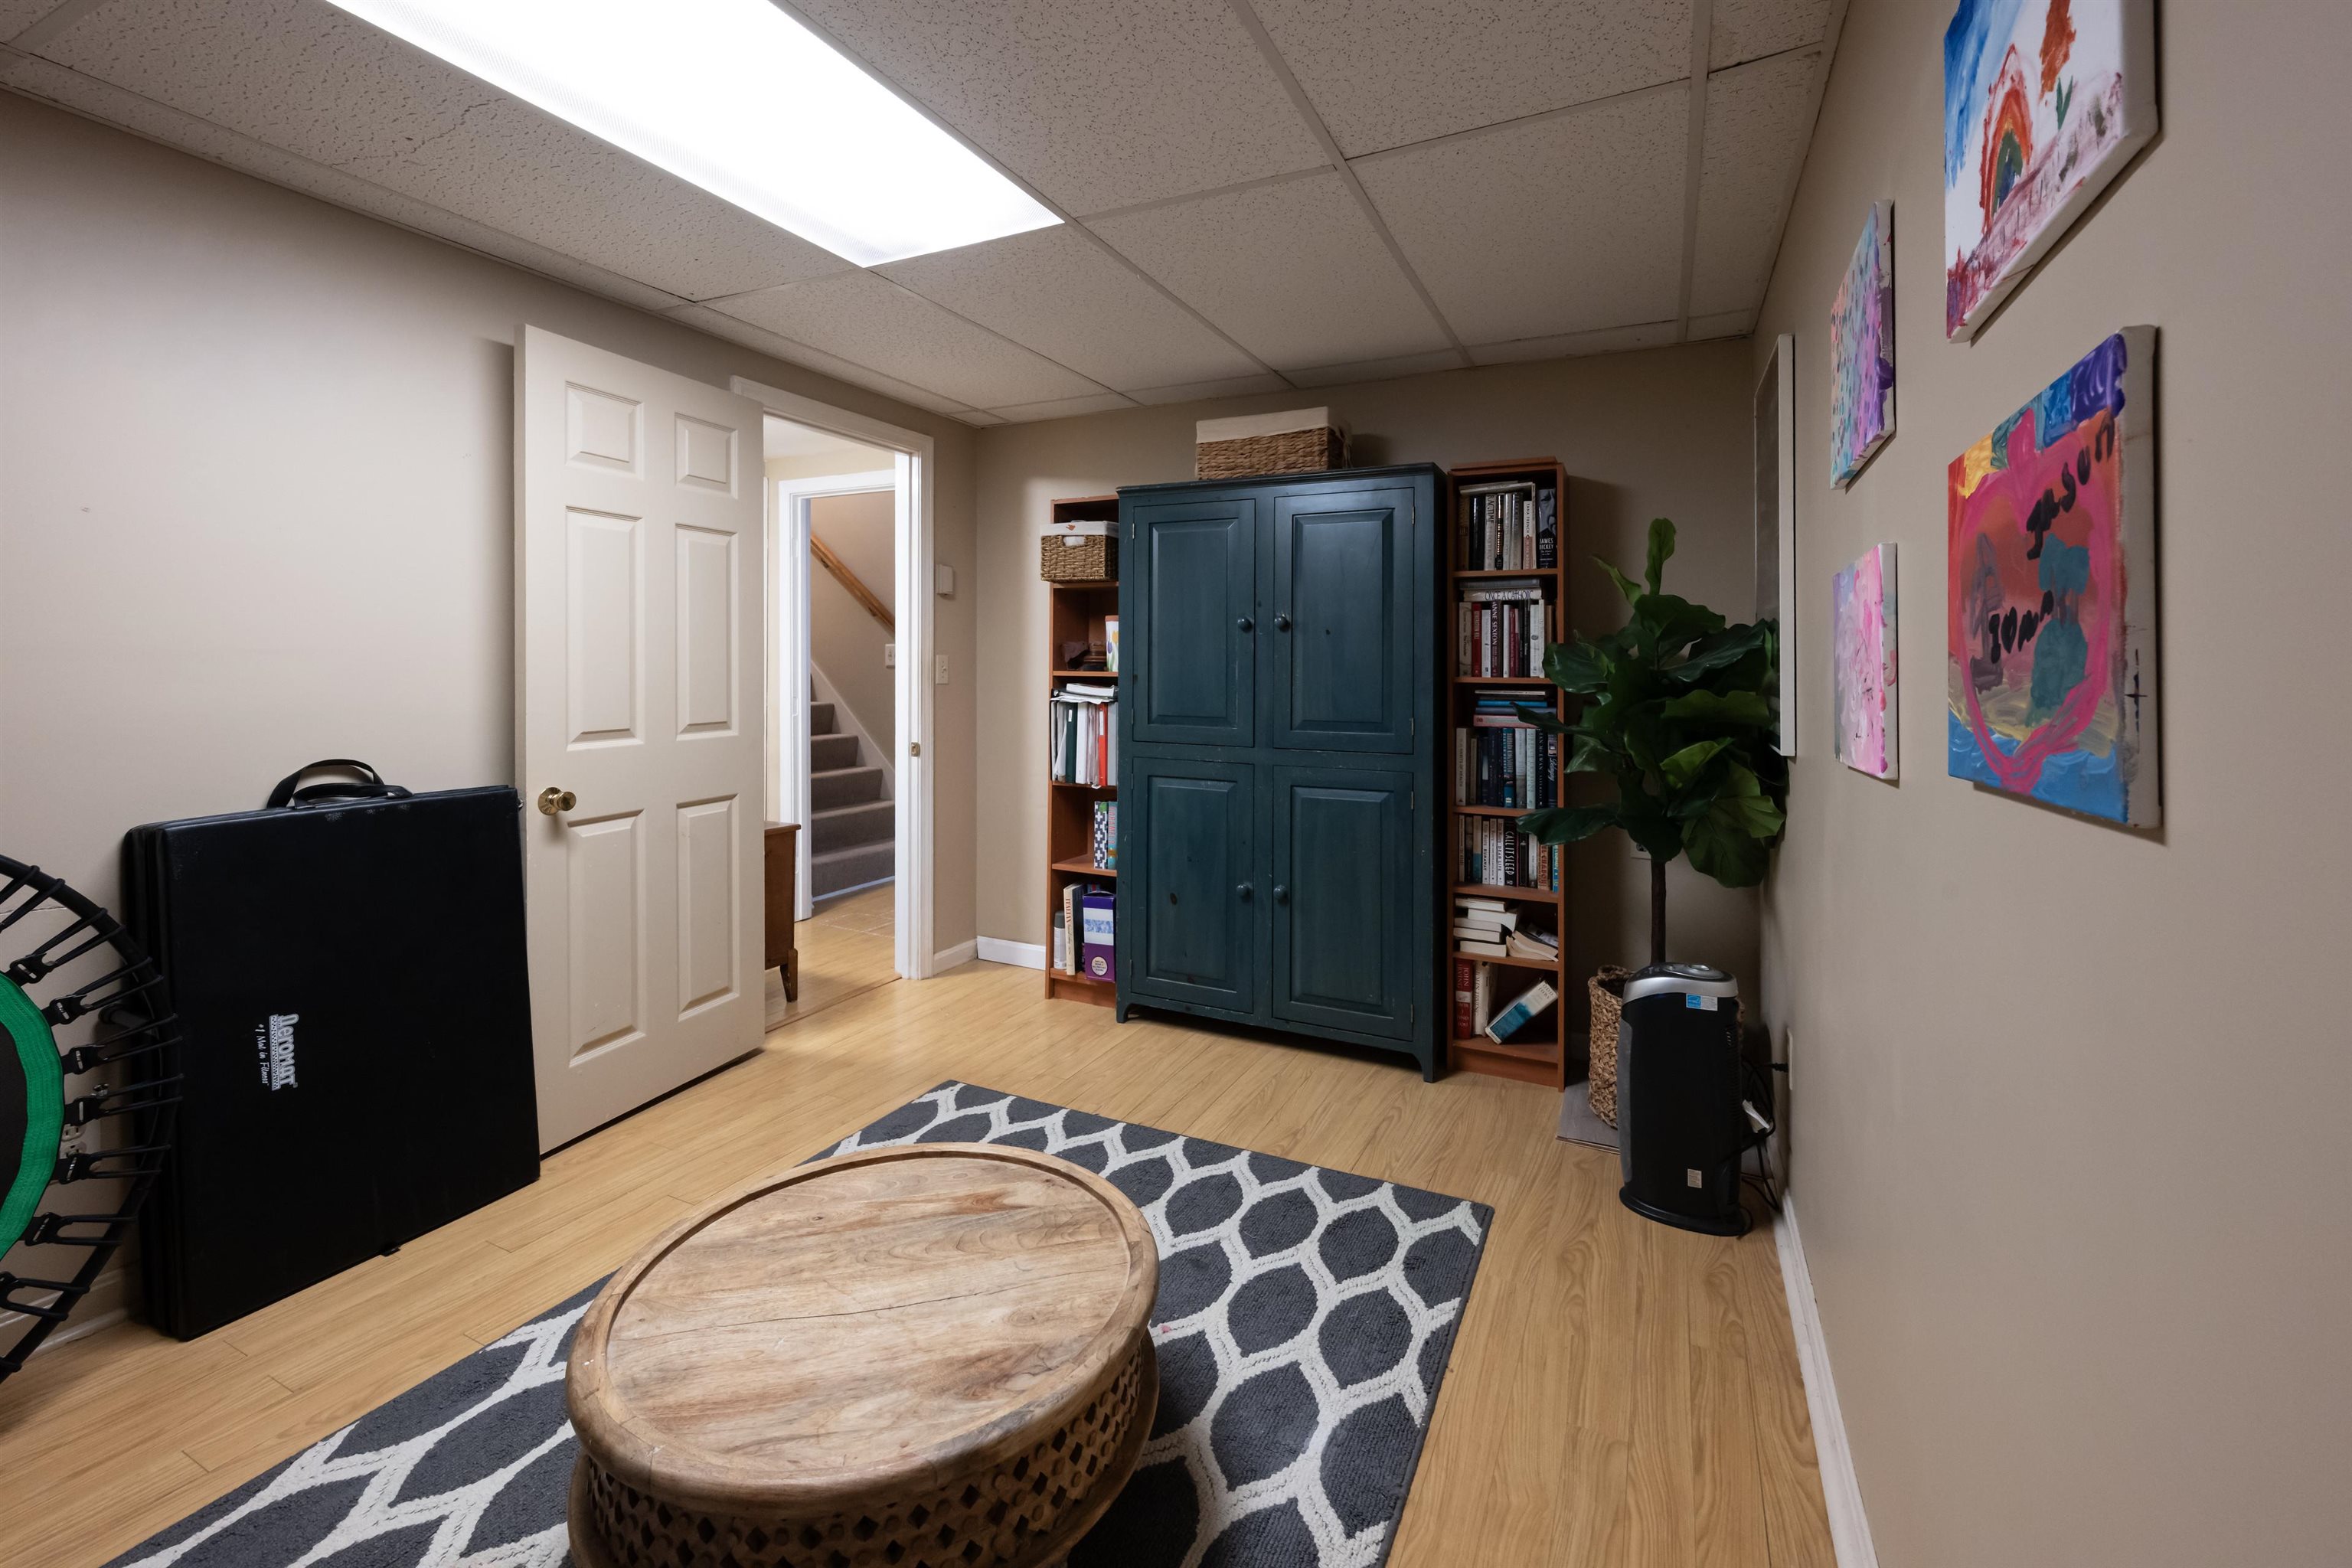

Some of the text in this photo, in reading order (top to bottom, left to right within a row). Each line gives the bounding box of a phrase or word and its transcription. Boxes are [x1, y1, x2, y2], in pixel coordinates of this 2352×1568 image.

[1486, 495, 1494, 524] RAGTIME
[1485, 590, 1534, 601] ONCE A CATHOLIC
[1505, 831, 1514, 848] CALL
[1505, 854, 1515, 876] SLEEP
[260, 1061, 270, 1084] Fitness
